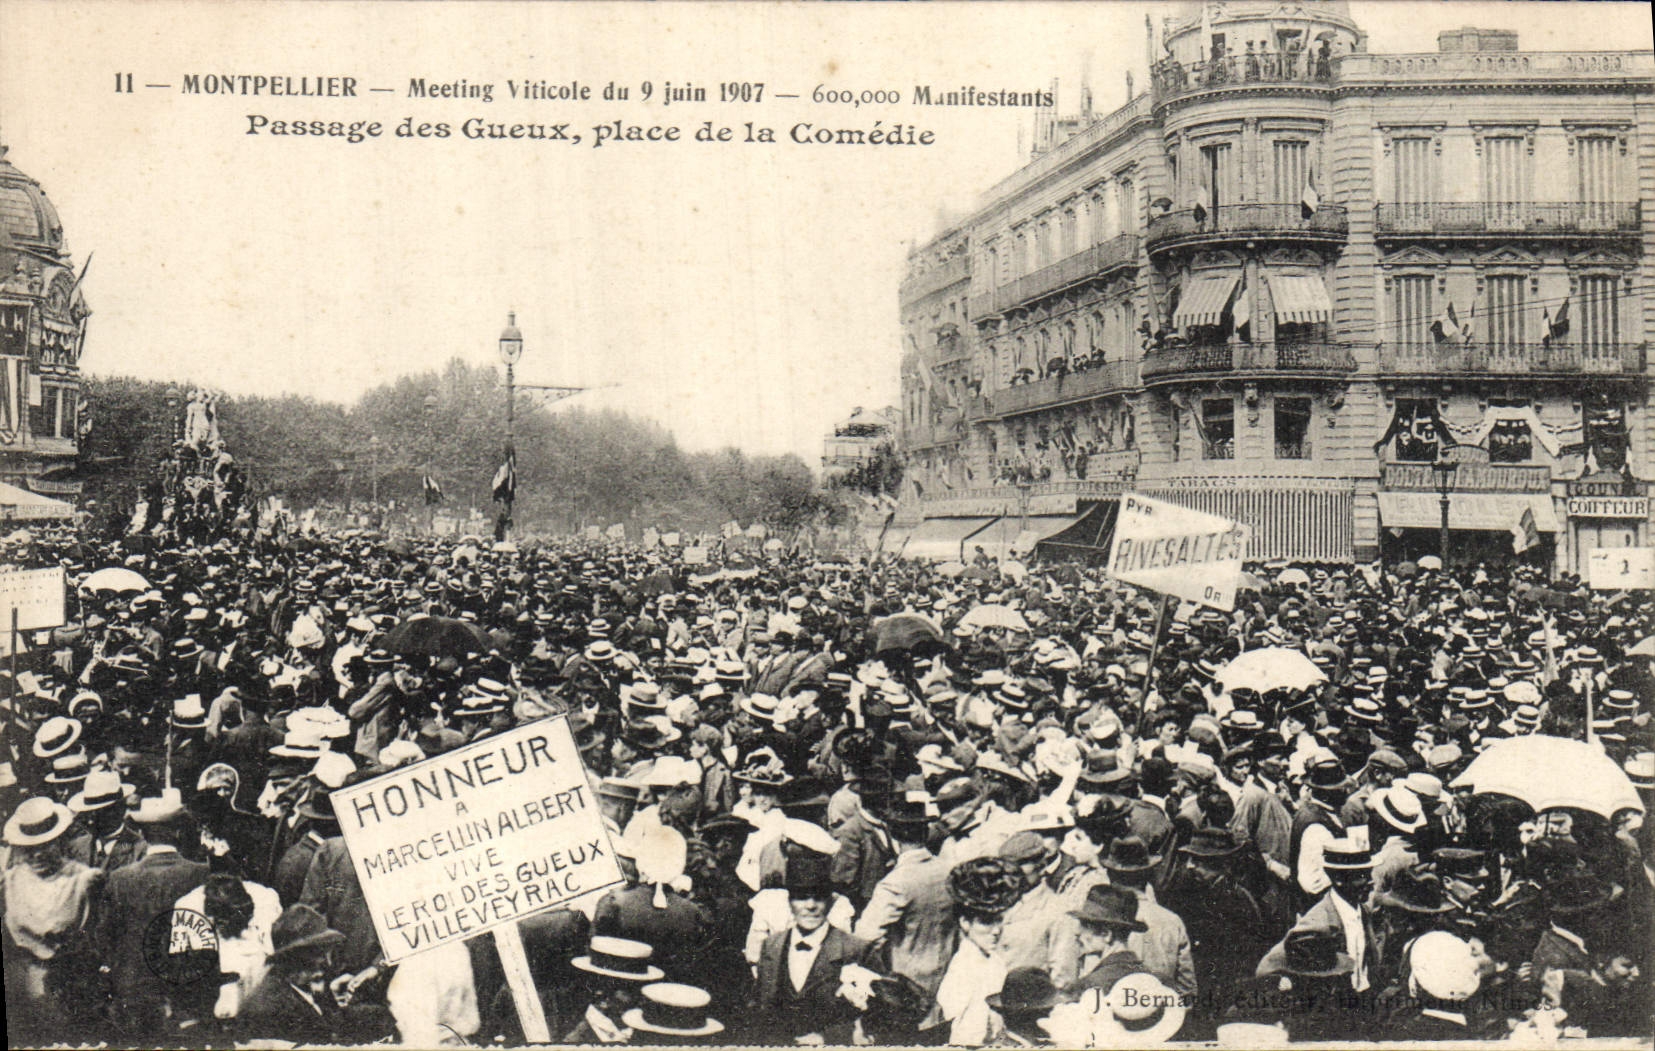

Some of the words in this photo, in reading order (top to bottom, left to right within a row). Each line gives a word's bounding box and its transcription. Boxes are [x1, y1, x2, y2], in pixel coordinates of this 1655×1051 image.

[1167, 478, 1237, 488] TABACS
[1568, 500, 1646, 515] COIFFEUR
[1113, 528, 1244, 573] RIVESALTES
[352, 735, 556, 828] HONNEUR
[363, 816, 494, 879] MARCELLIN
[497, 785, 588, 837] ALBERT
[383, 908, 410, 931] LE
[411, 891, 456, 921] ROI
[460, 873, 510, 905] DES
[516, 839, 605, 884] GUEUX
[444, 847, 503, 881] VIVE
[401, 872, 581, 950] VILLEVEYRAC
